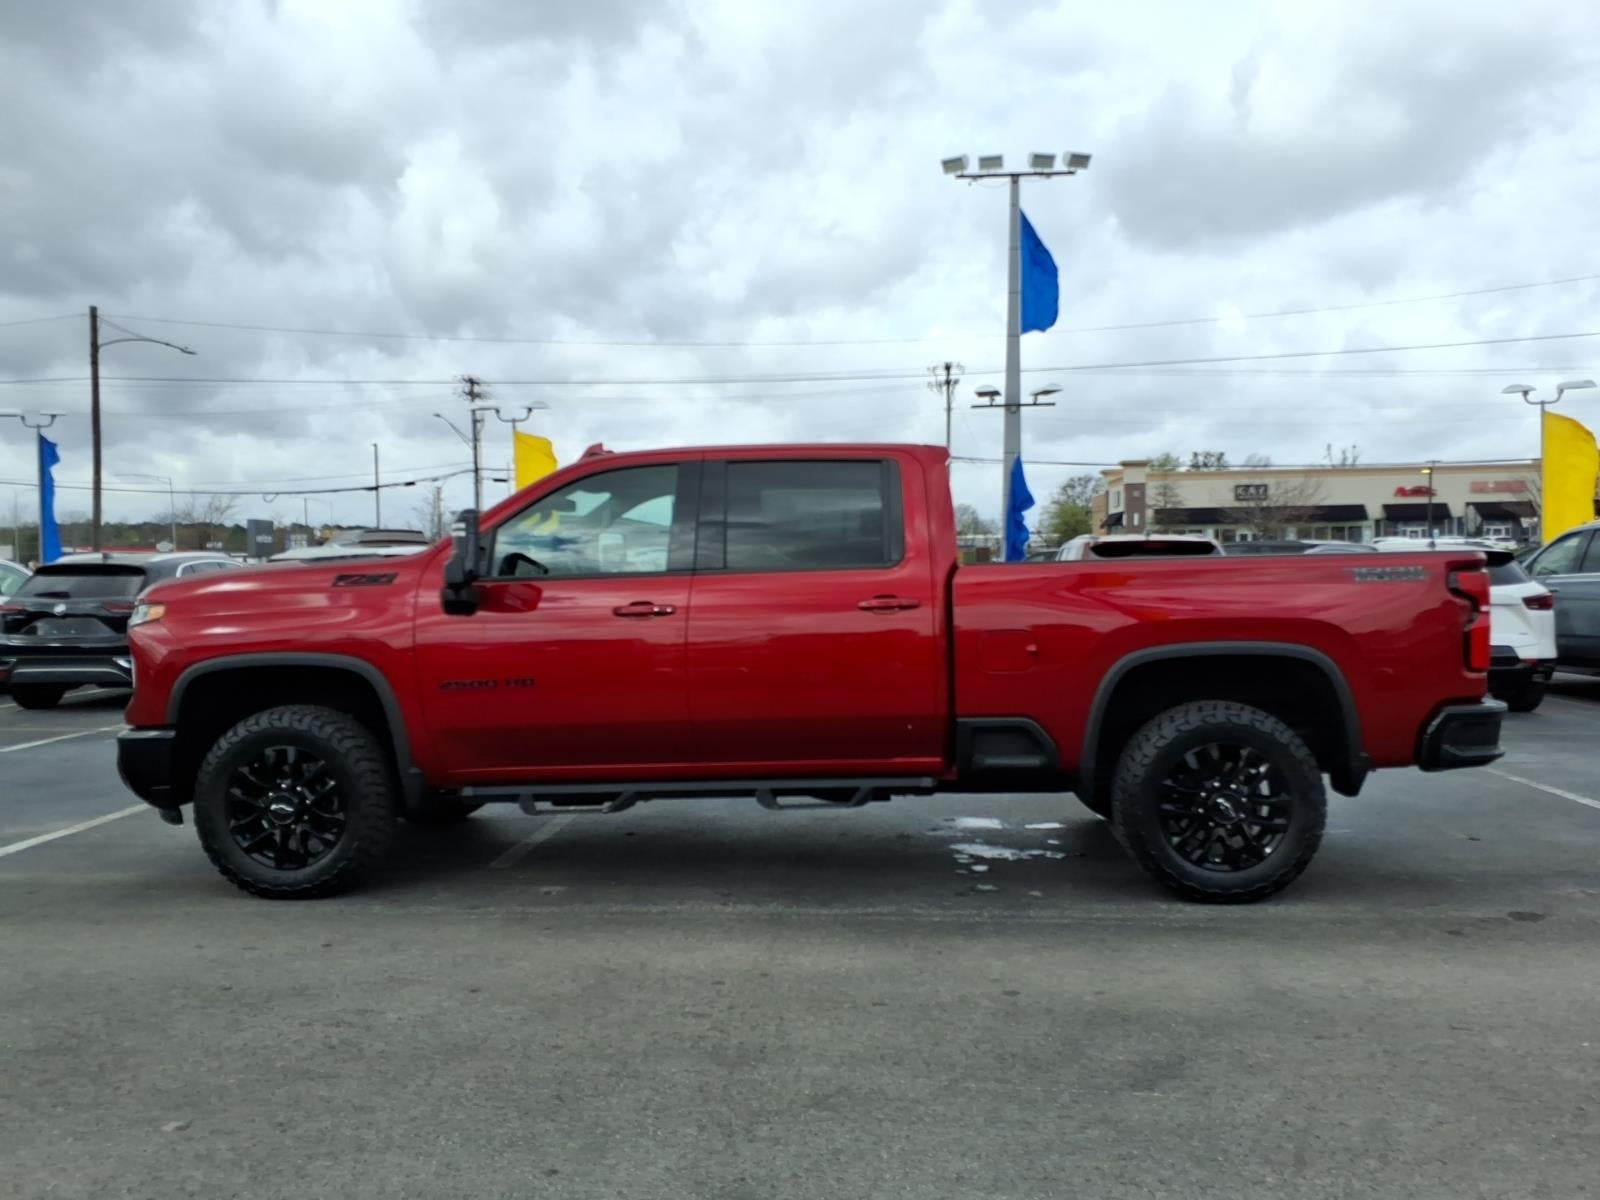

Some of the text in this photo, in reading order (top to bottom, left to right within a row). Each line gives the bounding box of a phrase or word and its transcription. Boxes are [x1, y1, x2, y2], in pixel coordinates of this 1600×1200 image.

[1236, 486, 1266, 497] KAY
[439, 677, 536, 689] 2500 HD
